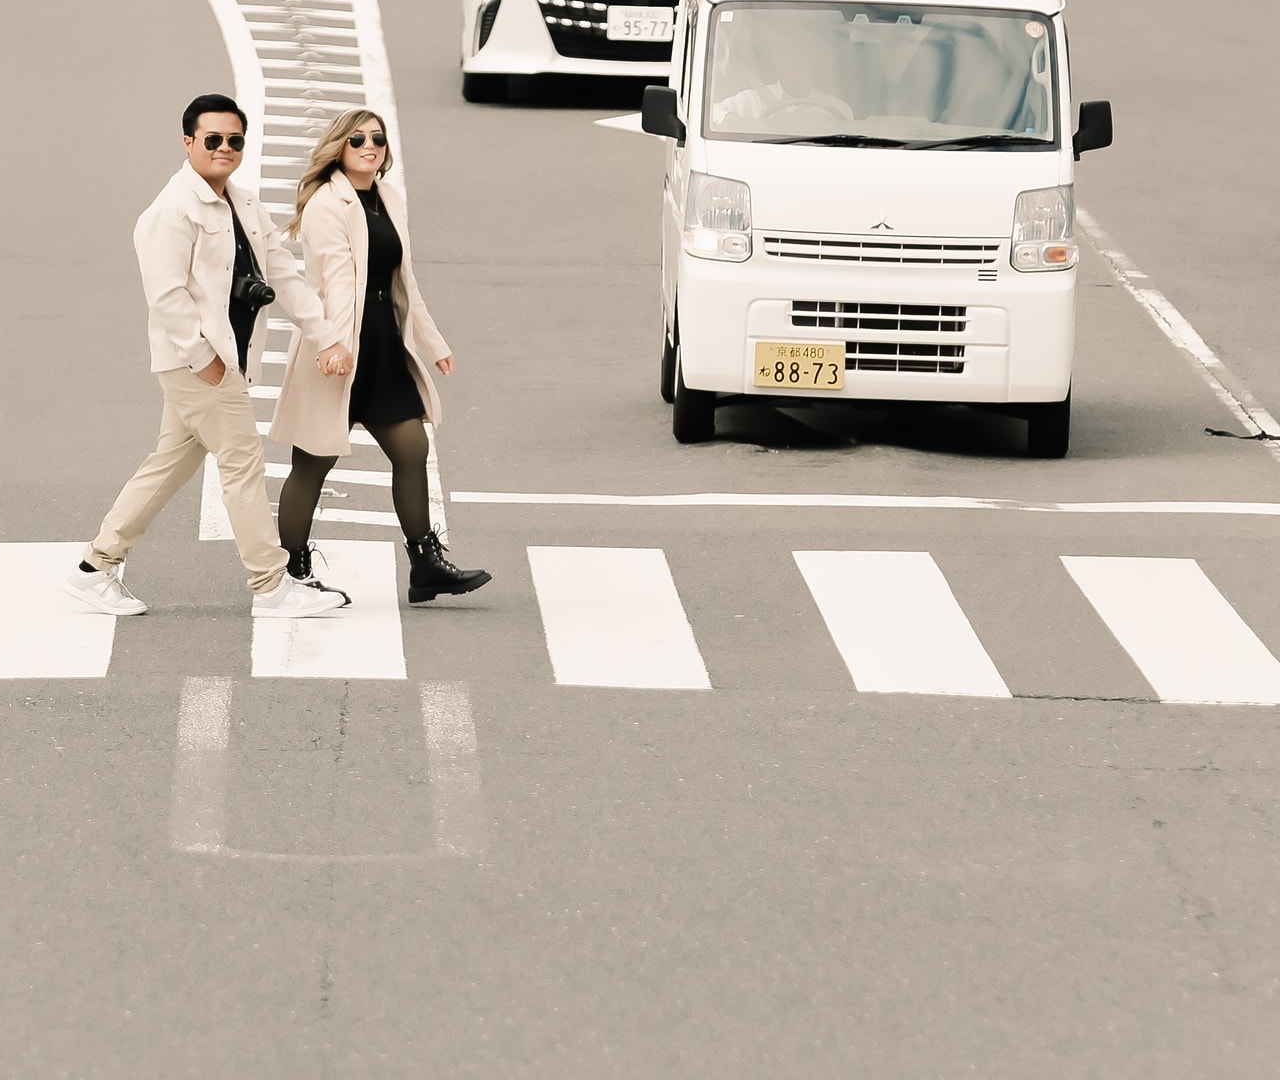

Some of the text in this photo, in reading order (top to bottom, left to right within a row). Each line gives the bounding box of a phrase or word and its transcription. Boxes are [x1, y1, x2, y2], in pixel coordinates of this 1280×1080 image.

[623, 20, 668, 37] 95-77
[759, 361, 838, 385] ね 88-73
